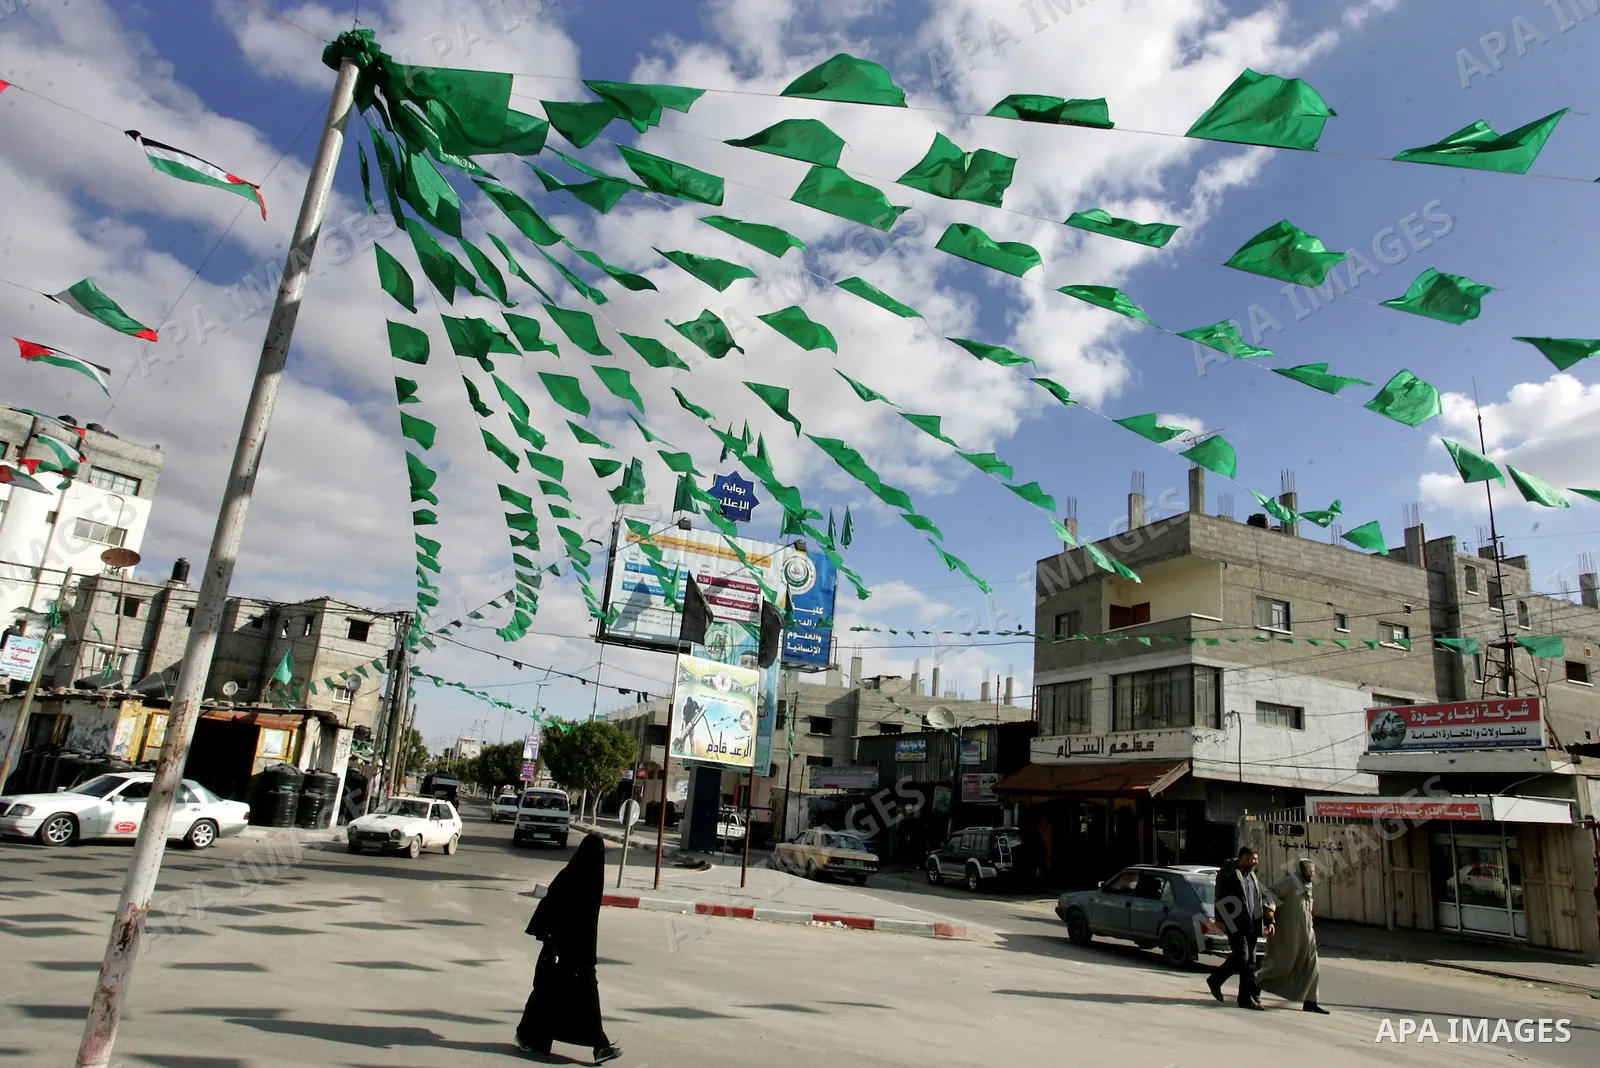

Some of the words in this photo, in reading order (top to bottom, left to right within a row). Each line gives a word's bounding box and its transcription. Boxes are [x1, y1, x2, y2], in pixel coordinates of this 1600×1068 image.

[723, 482, 746, 496] بوابة
[787, 631, 822, 643] والعلوم
[786, 642, 821, 656] الإنسانية
[1411, 710, 1444, 724] جودة
[1447, 704, 1479, 723] أبناء
[1482, 701, 1529, 720] شركة
[1411, 729, 1442, 740] العامة
[1442, 728, 1480, 740] والتجارة
[1481, 726, 1527, 738] للمقاولات
[706, 731, 728, 755] قادم
[729, 737, 753, 759] الرعب
[1056, 736, 1104, 758] السلام
[1108, 735, 1154, 757] مطعم
[1444, 806, 1480, 819] شركة
